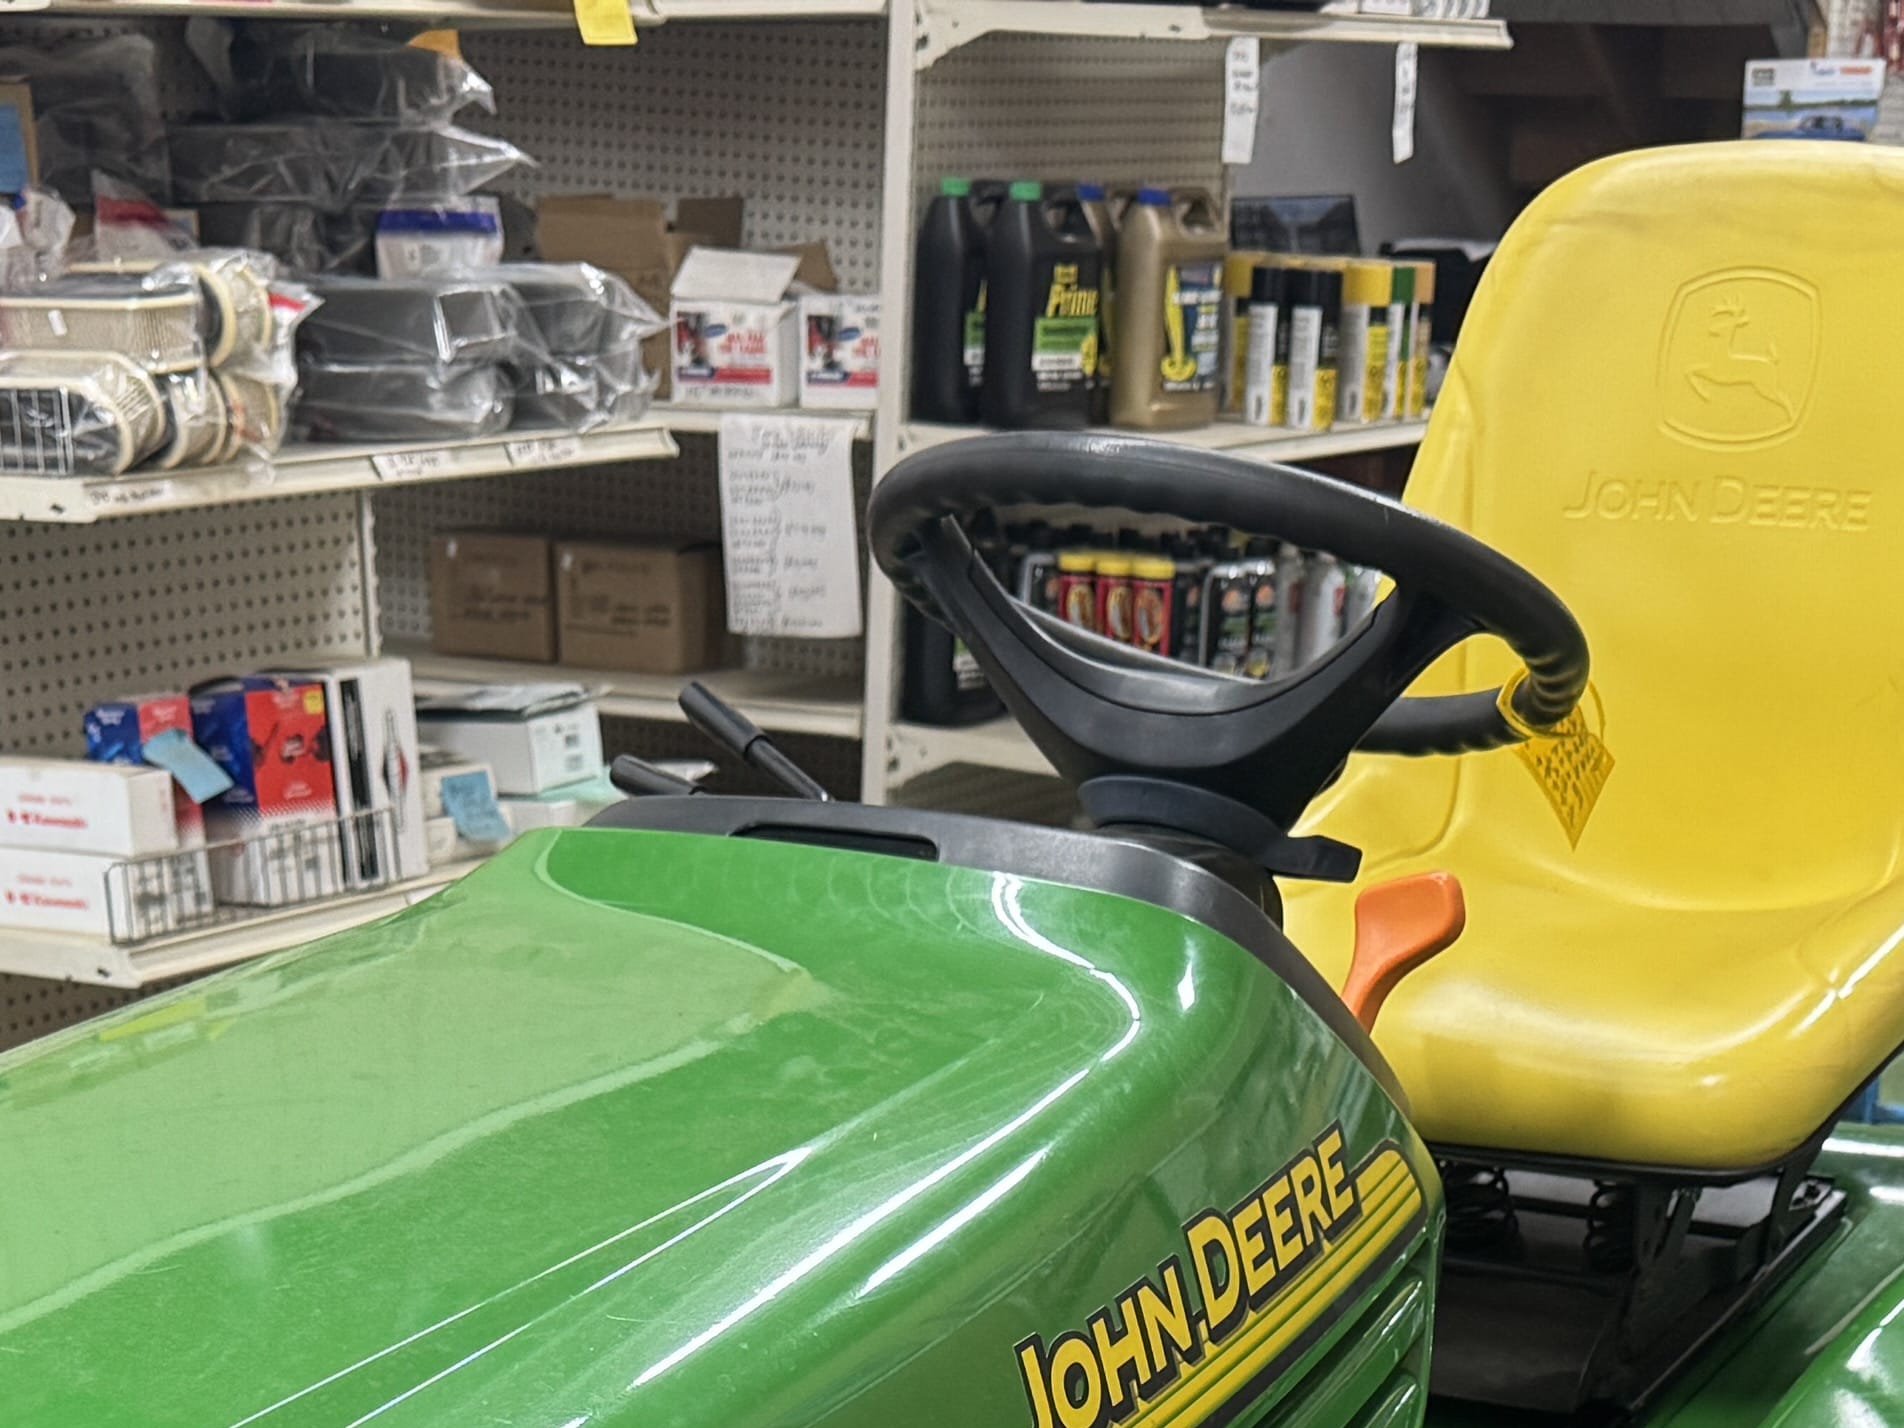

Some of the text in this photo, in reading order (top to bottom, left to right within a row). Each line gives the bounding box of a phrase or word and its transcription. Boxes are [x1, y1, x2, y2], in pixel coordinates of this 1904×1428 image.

[1561, 469, 1872, 531] JOHN DEERE
[1185, 1124, 1355, 1332] DEERE
